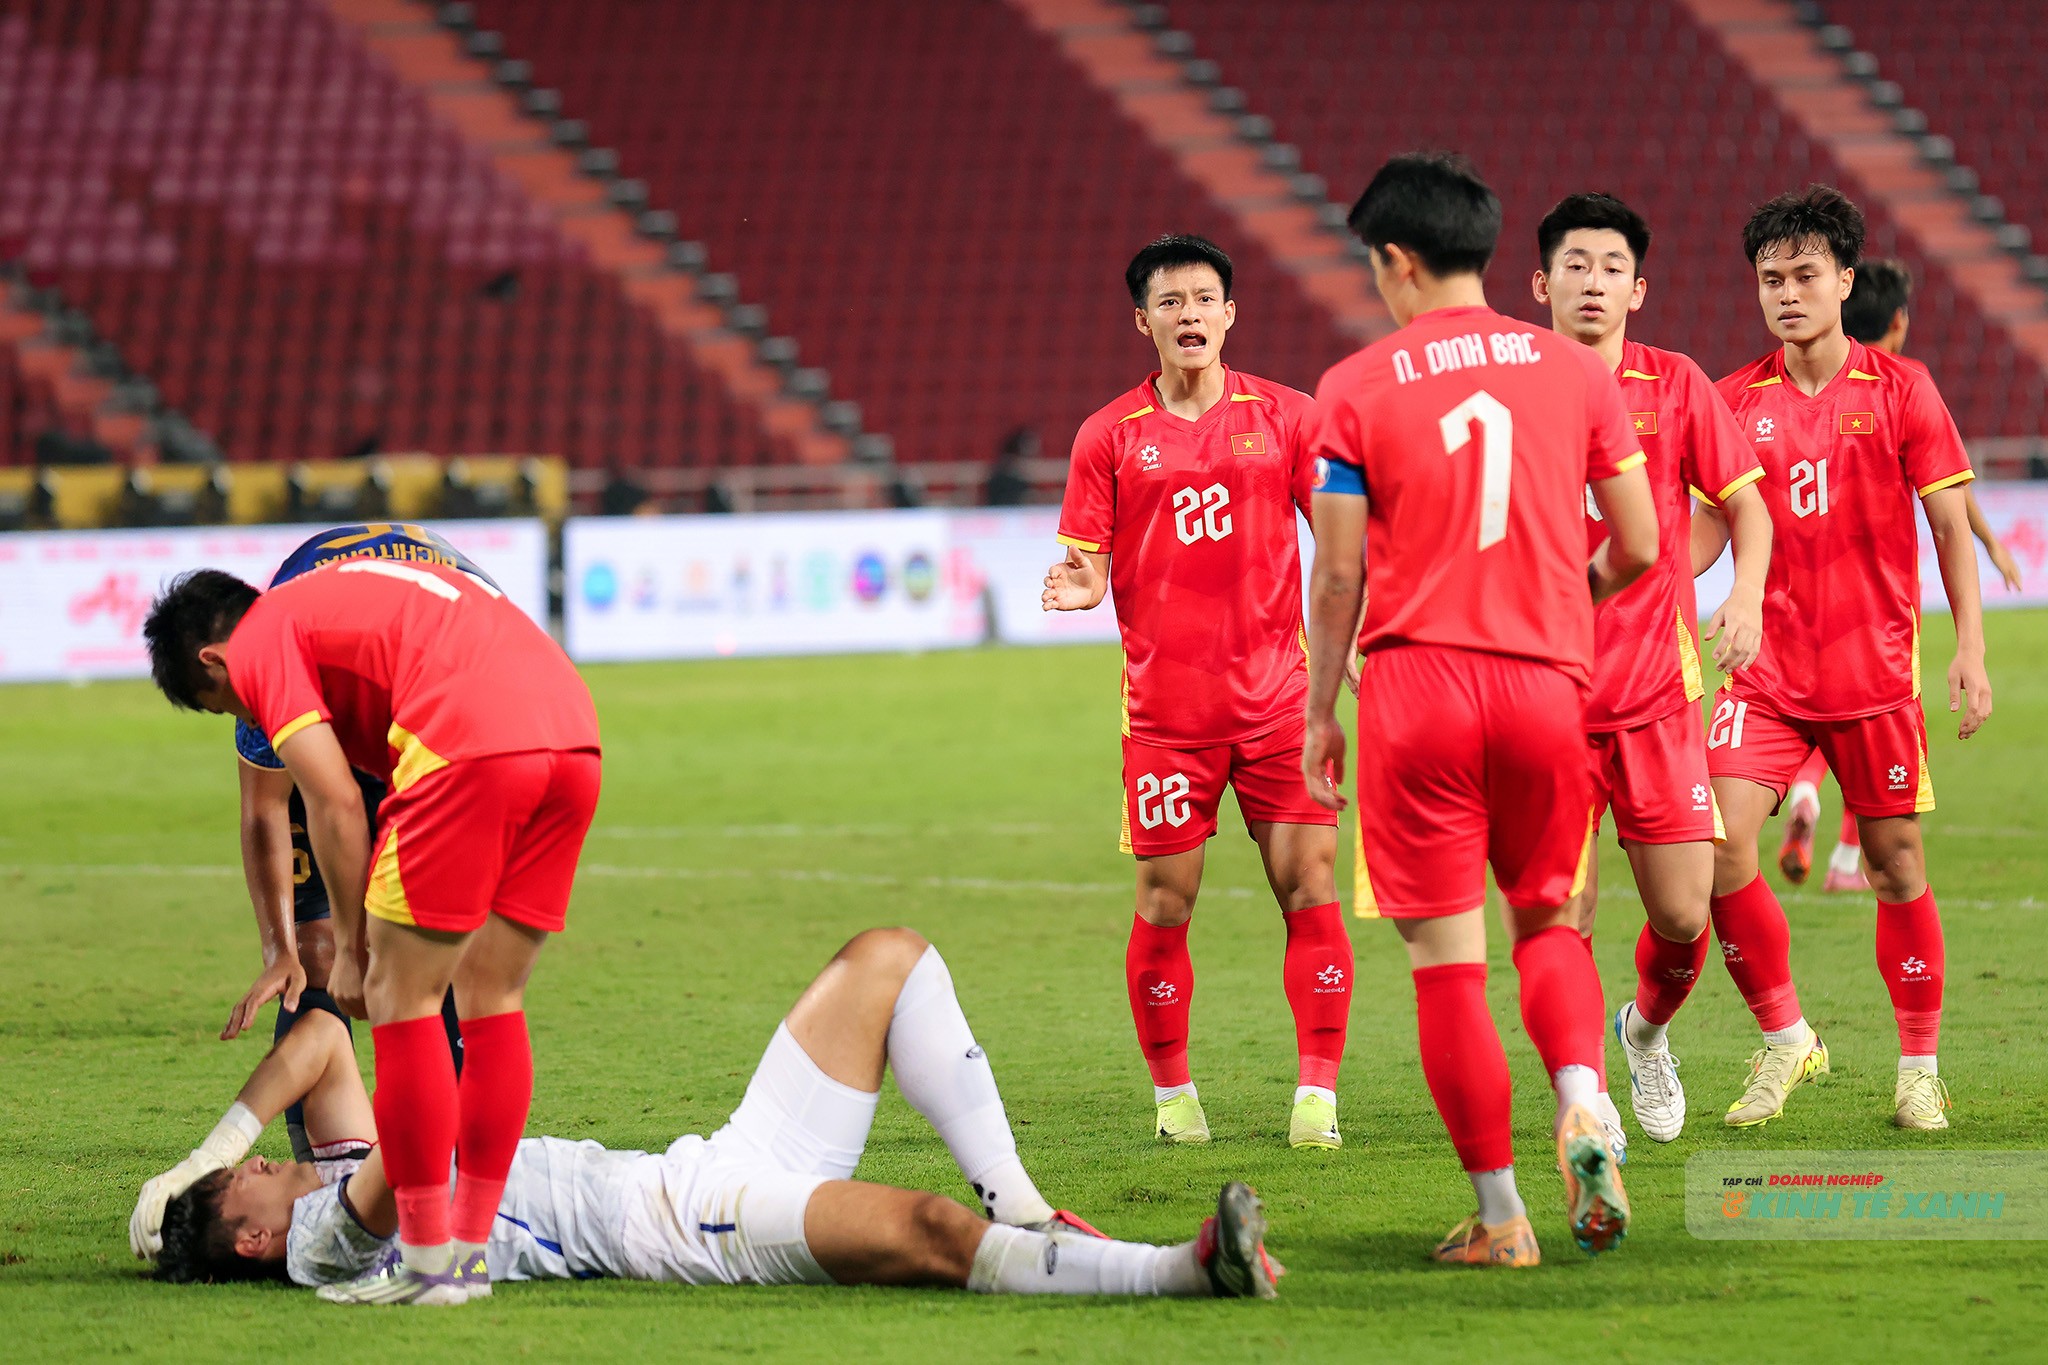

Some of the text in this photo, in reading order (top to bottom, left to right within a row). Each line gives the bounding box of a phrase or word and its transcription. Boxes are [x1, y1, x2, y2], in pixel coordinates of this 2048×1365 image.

[1488, 331, 1542, 366] BAC
[1438, 389, 1513, 552] 7
[1789, 457, 1829, 519] 21
[1172, 482, 1234, 547] 22
[1706, 698, 1749, 751] 21
[1136, 771, 1192, 831] 22
